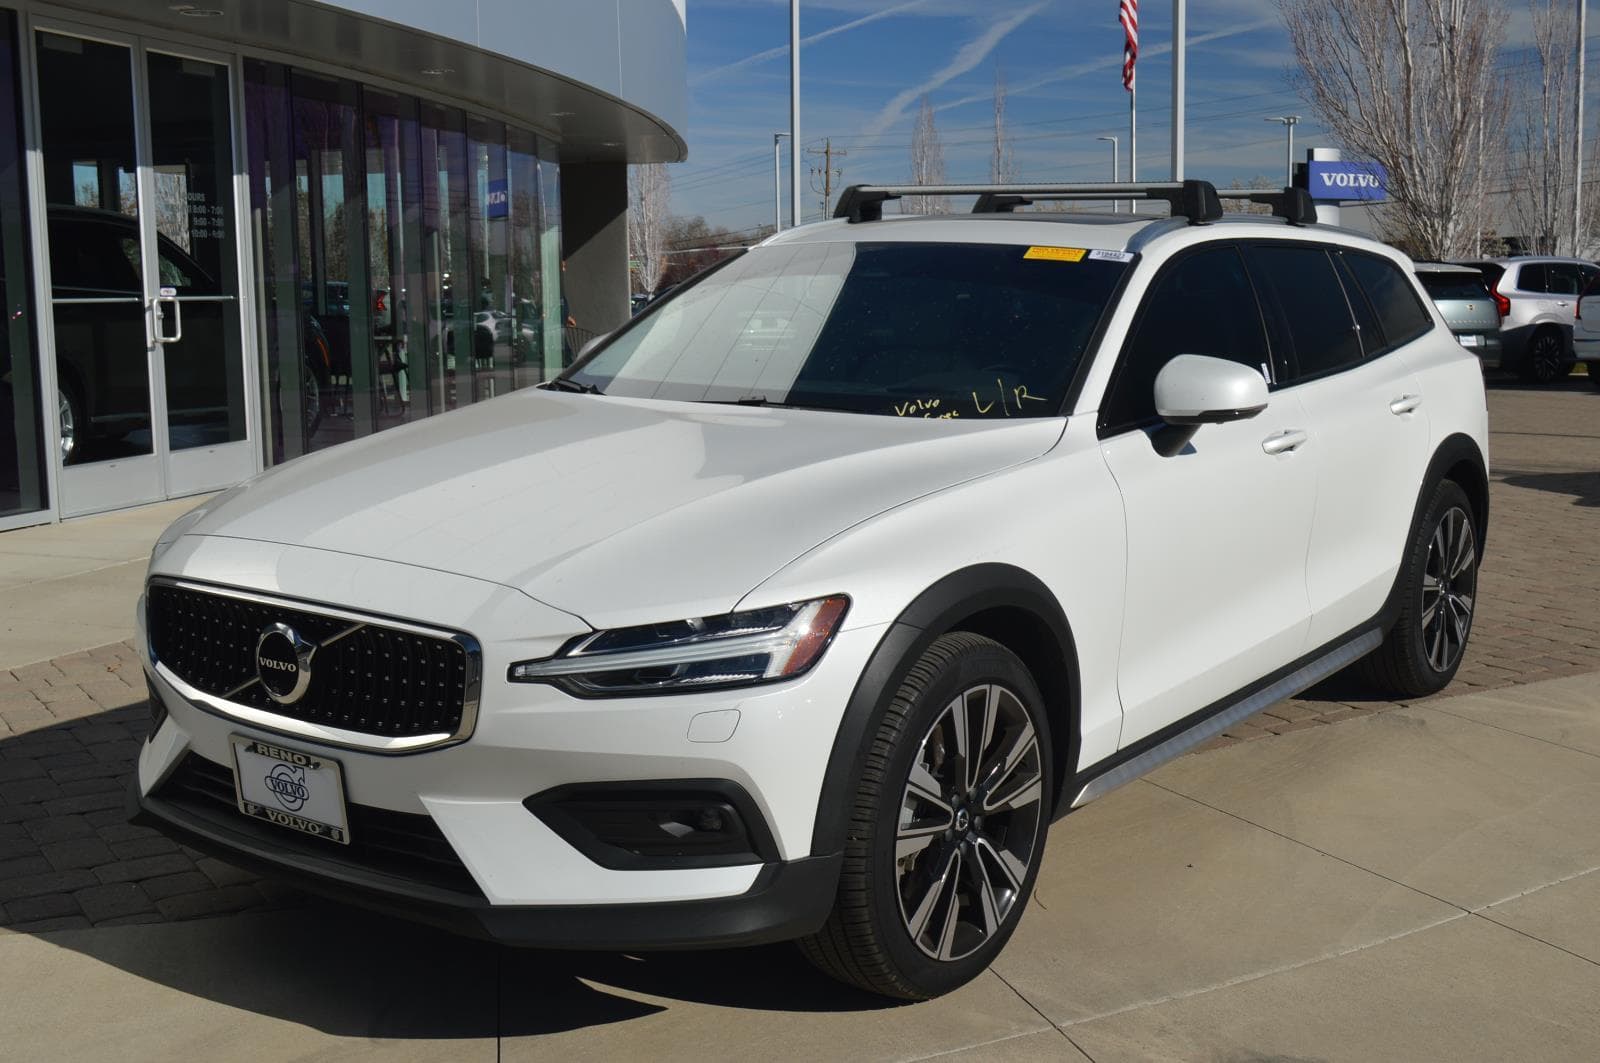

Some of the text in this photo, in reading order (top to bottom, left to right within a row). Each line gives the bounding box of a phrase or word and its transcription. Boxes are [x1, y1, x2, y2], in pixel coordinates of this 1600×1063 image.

[1320, 172, 1380, 188] VOLVO
[894, 399, 941, 417] Volvo
[259, 656, 297, 673] VOLVO
[257, 744, 307, 766] RENO
[270, 778, 305, 798] VOLVO
[265, 809, 321, 835] VOLVO
